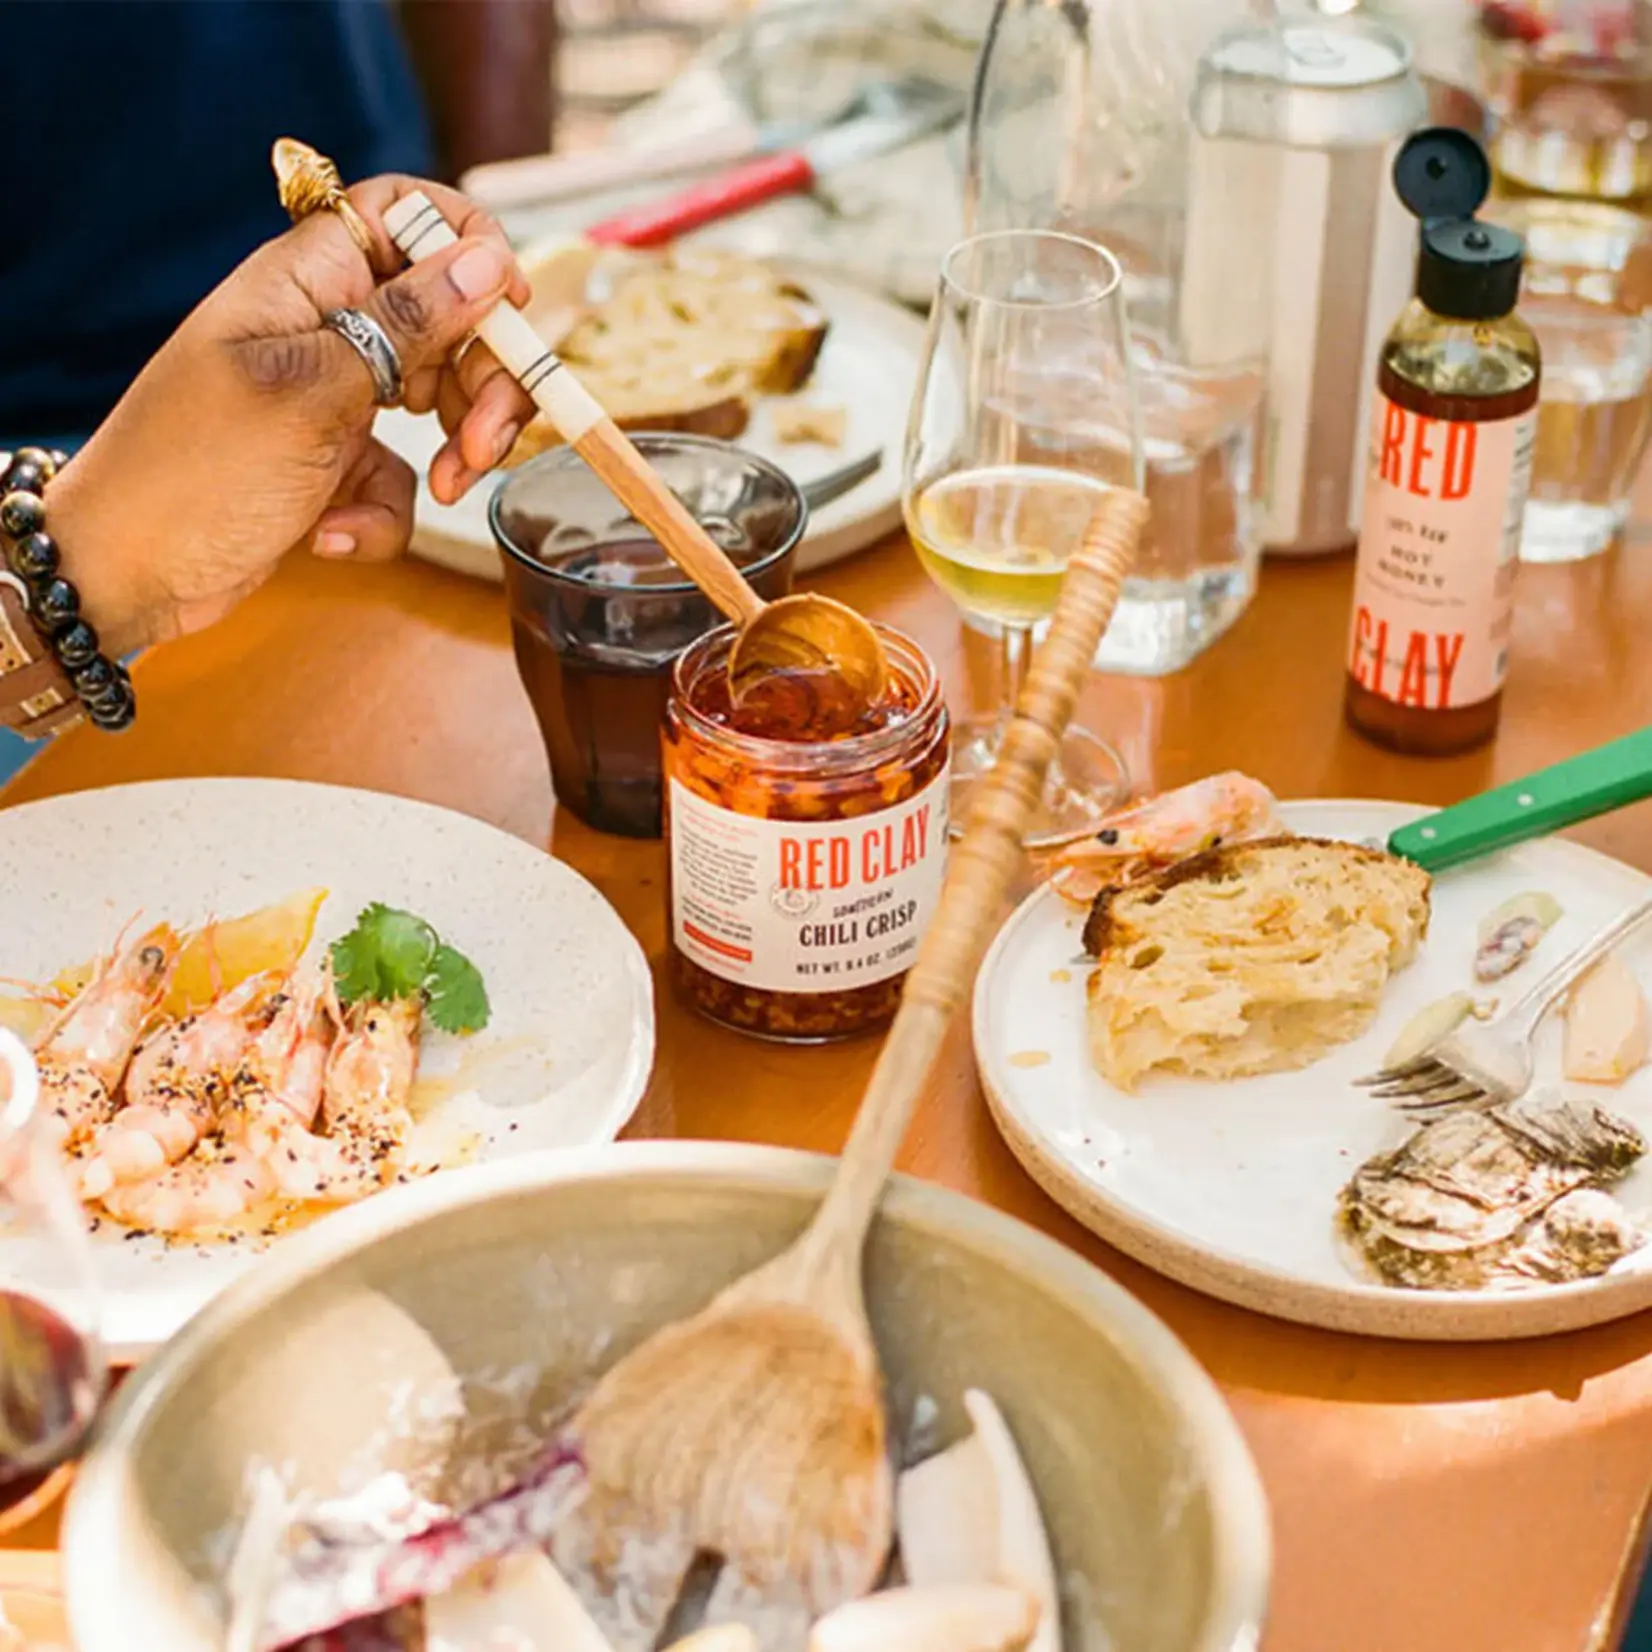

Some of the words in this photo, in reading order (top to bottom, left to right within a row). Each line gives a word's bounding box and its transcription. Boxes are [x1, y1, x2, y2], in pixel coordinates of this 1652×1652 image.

[1380, 401, 1478, 501] RED
[1378, 558, 1445, 589] HONEY
[1391, 545, 1432, 567] HOT
[1353, 605, 1465, 709] CLAY
[779, 836, 850, 891] RED
[861, 803, 931, 884] CLAY
[799, 922, 858, 947] CHILI
[866, 900, 917, 939] CRISP
[796, 963, 818, 974] NET
